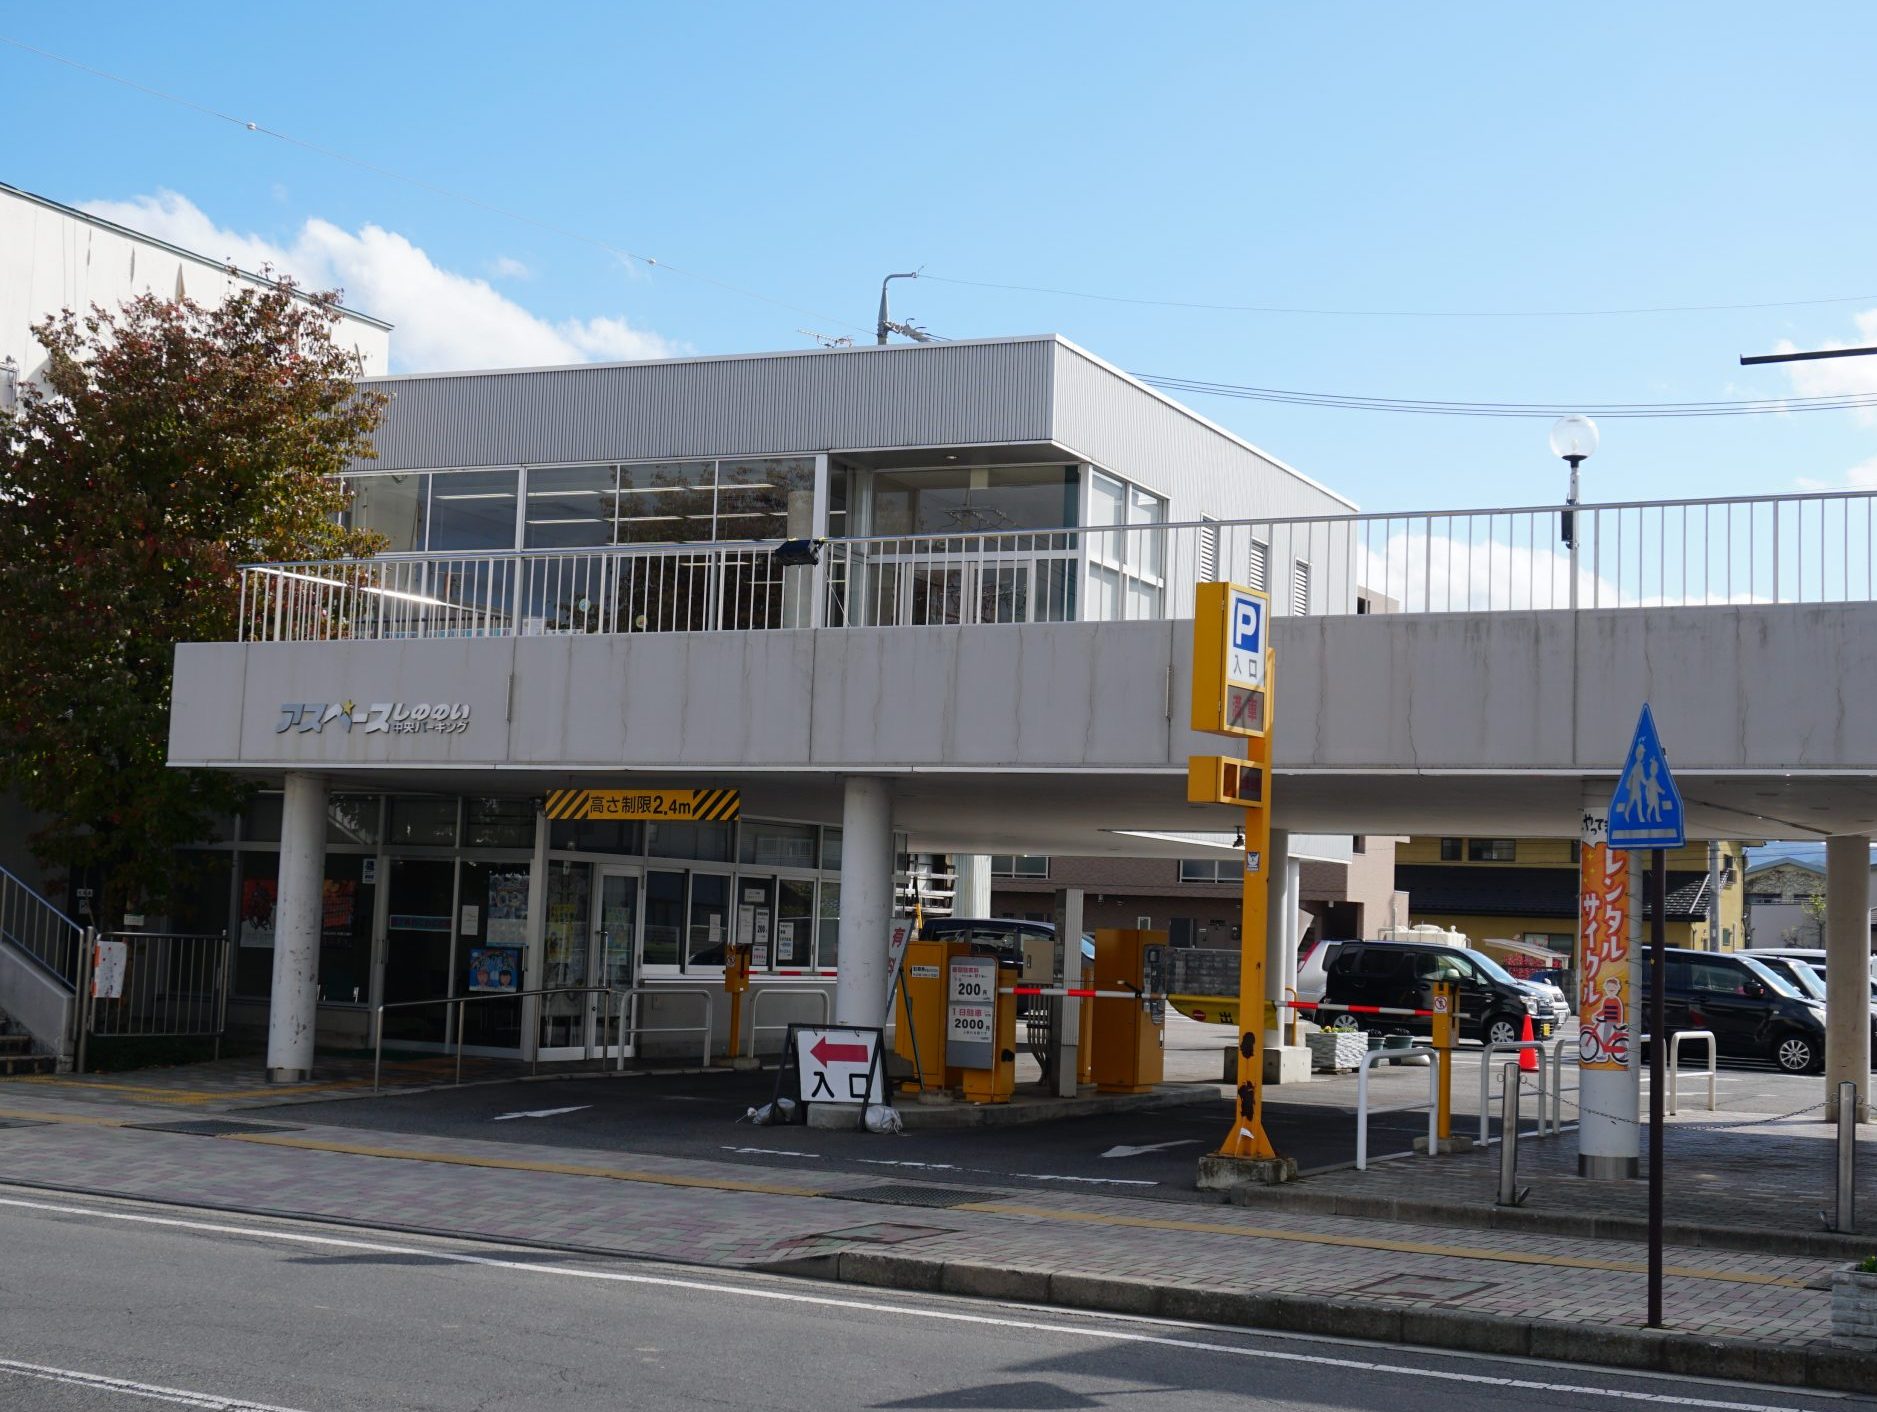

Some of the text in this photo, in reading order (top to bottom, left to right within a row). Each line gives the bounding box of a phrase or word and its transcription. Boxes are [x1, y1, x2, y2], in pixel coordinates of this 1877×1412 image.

[1233, 654, 1258, 678] 入口
[1603, 849, 1625, 962] レンタル
[1583, 892, 1601, 1005] サイクル
[811, 1071, 871, 1099] 入口
